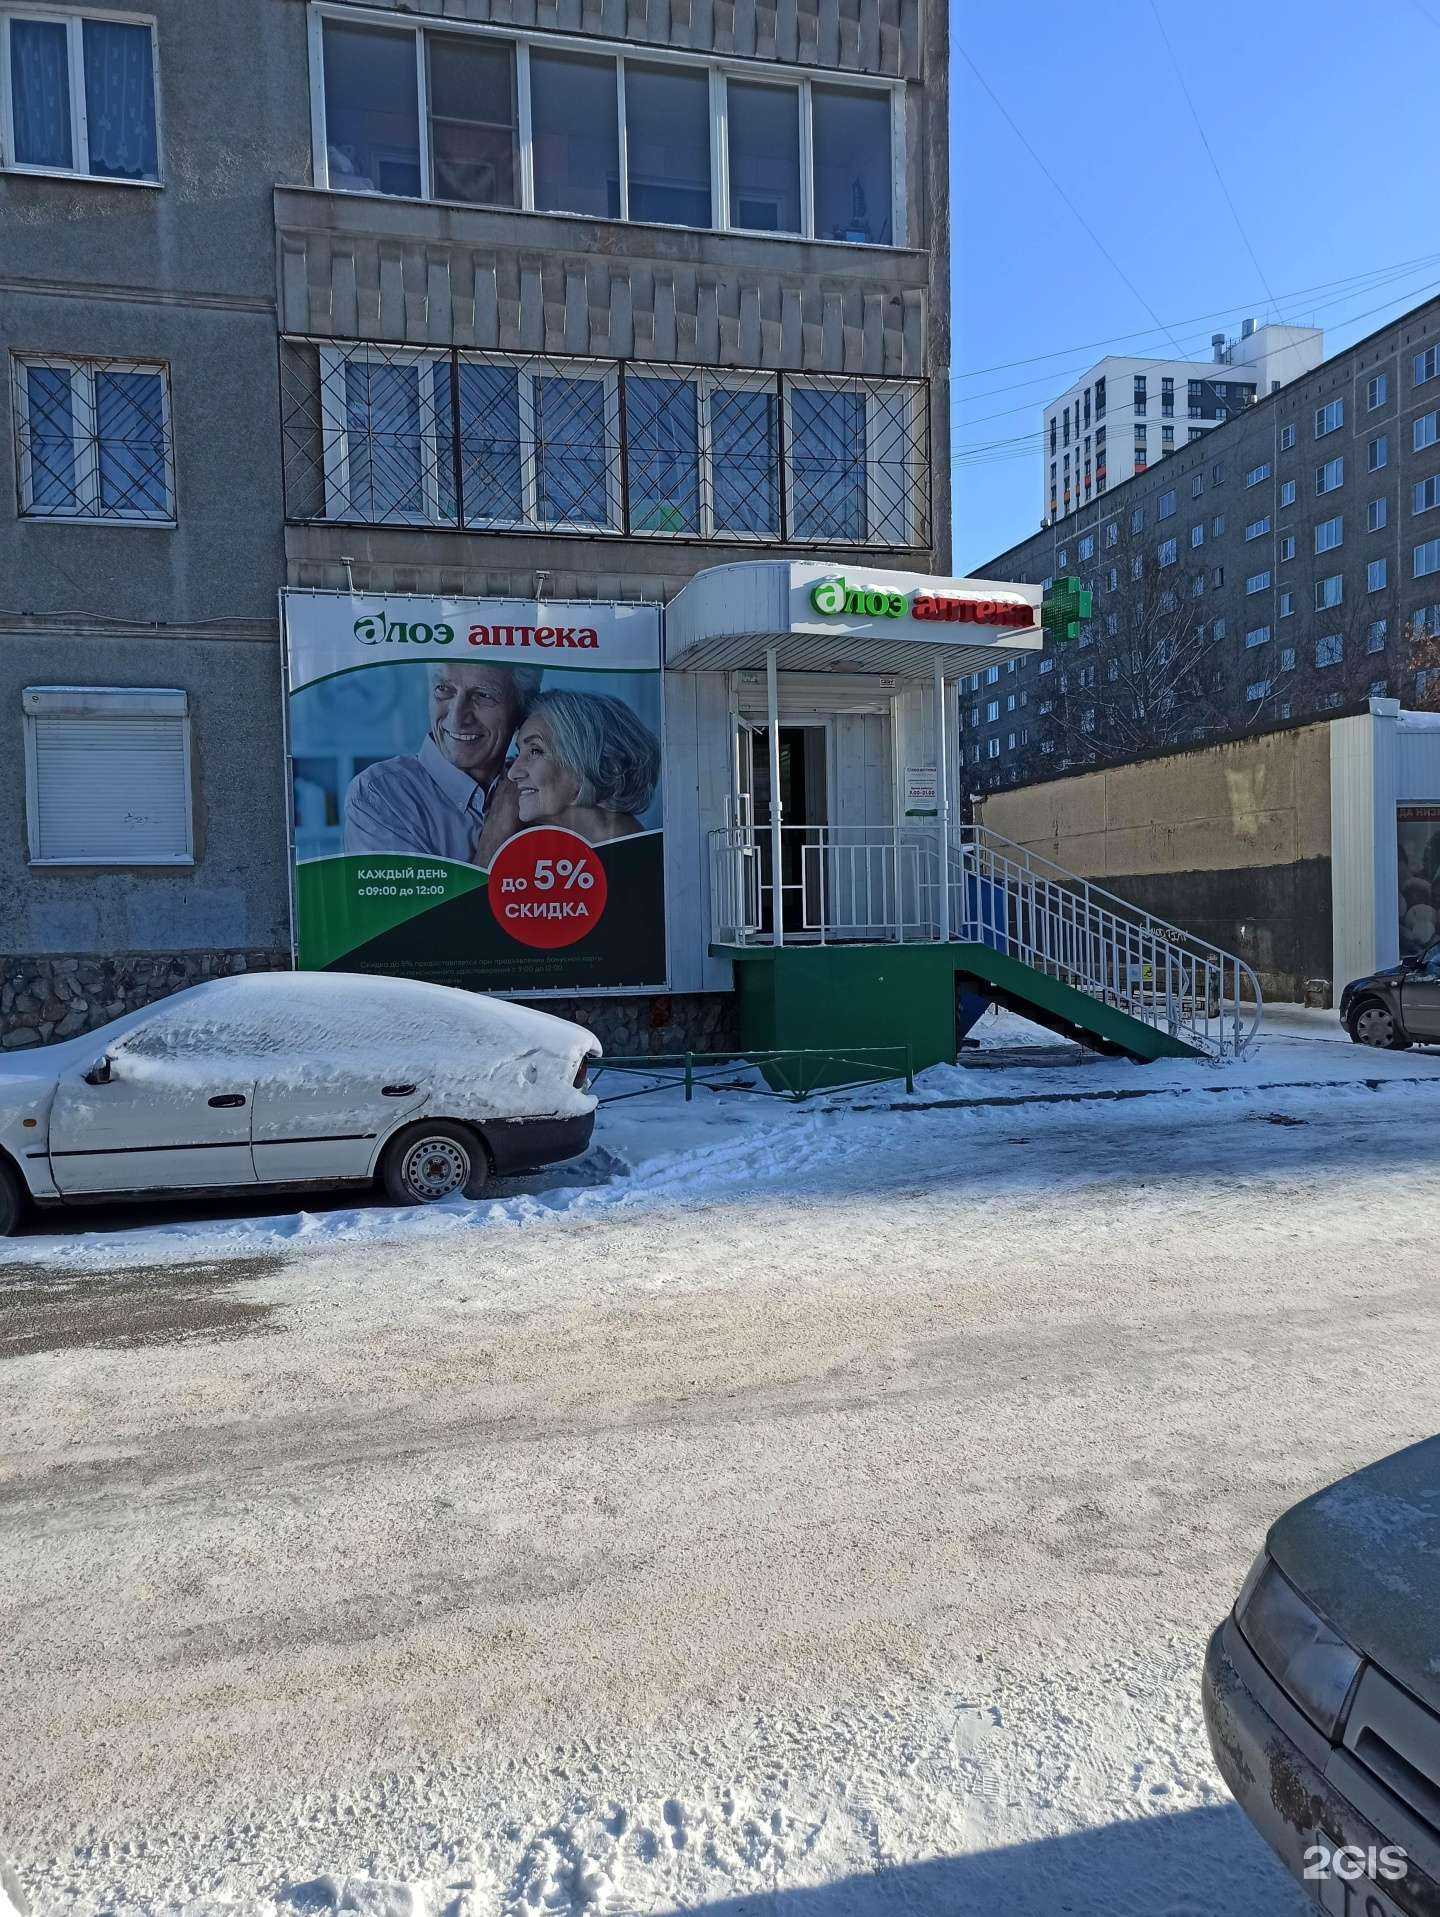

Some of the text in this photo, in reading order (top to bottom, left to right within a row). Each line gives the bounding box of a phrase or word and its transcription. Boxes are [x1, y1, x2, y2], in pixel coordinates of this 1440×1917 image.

[467, 623, 600, 649] аптека
[357, 867, 448, 880] КАЖДЫЙ ДЕНЬ
[501, 859, 594, 893] до 5%
[399, 888, 414, 897] до
[415, 885, 445, 896] 12:00
[505, 902, 590, 920] СКИДКА
